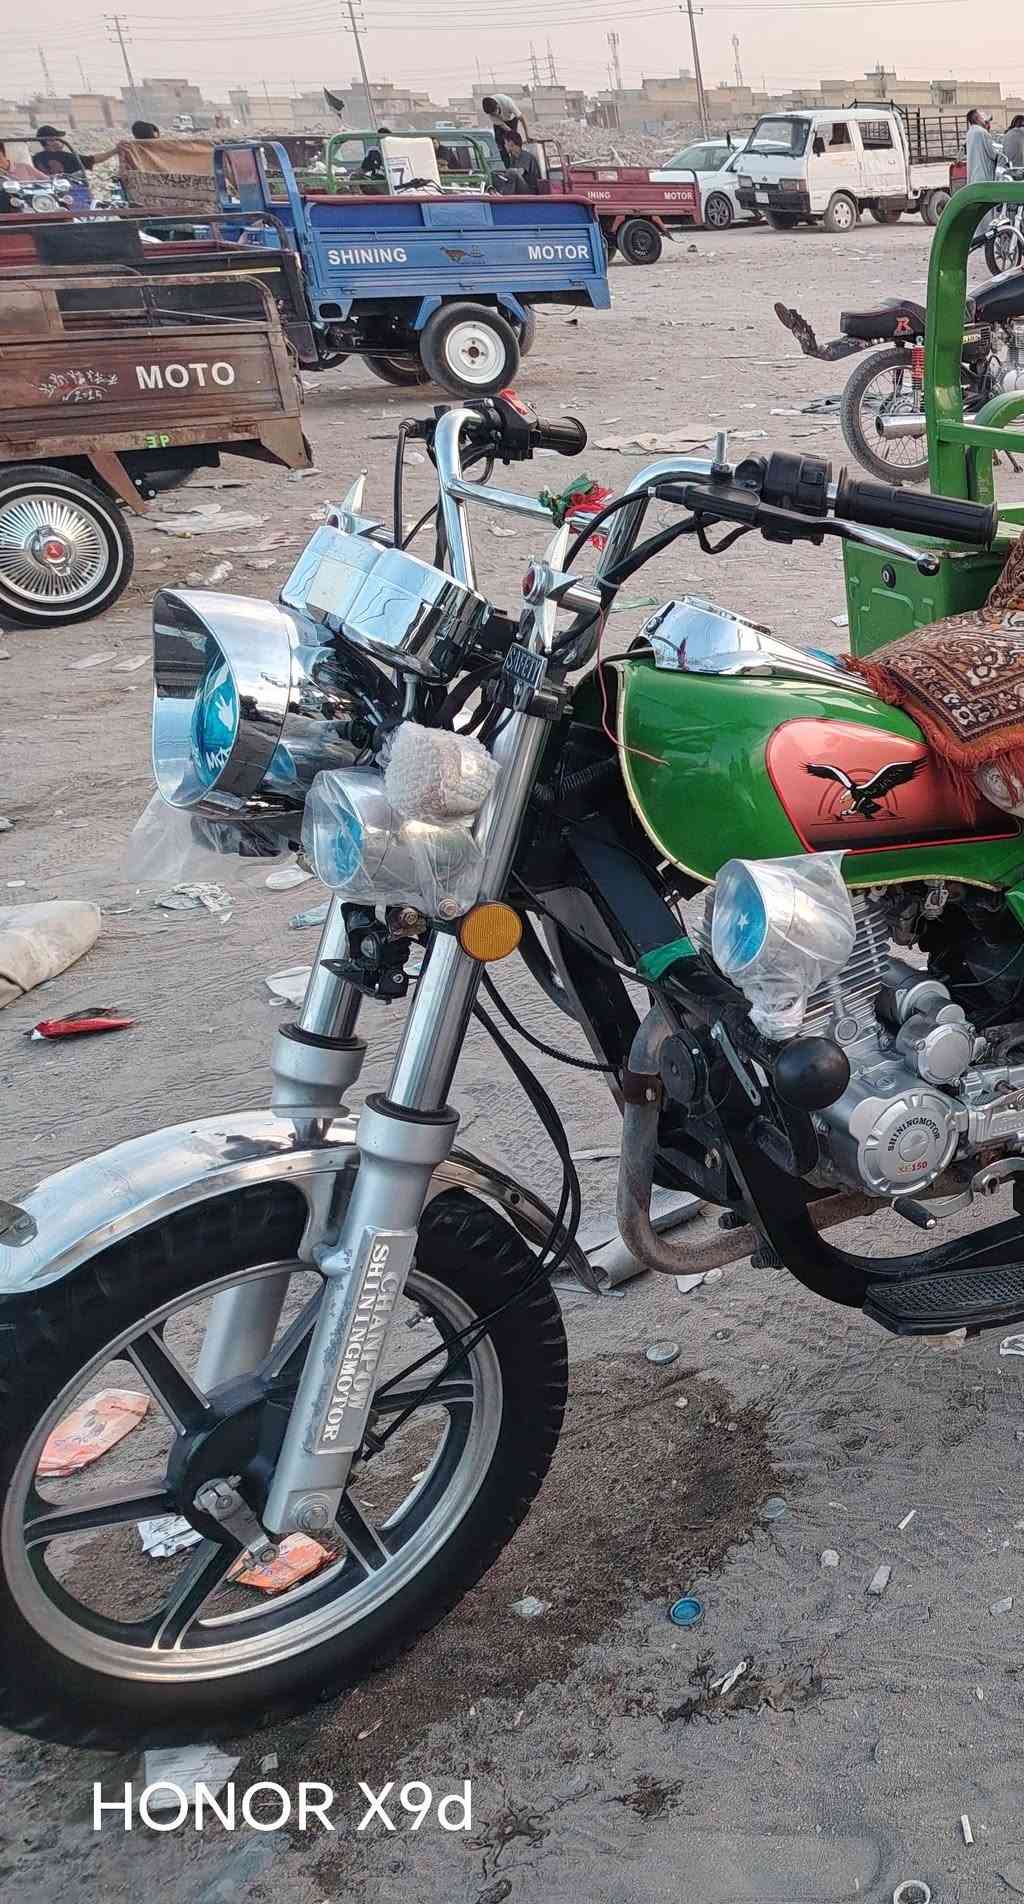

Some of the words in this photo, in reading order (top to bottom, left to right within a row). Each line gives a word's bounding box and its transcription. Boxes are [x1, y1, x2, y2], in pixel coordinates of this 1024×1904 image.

[664, 192, 693, 200] MOTOR
[328, 247, 408, 265] SHINING
[528, 245, 589, 260] MOTOR
[135, 361, 236, 390] MOTO
[321, 1243, 390, 1442] SHININGMOTOR
[347, 1271, 400, 1410] CHANPOW
